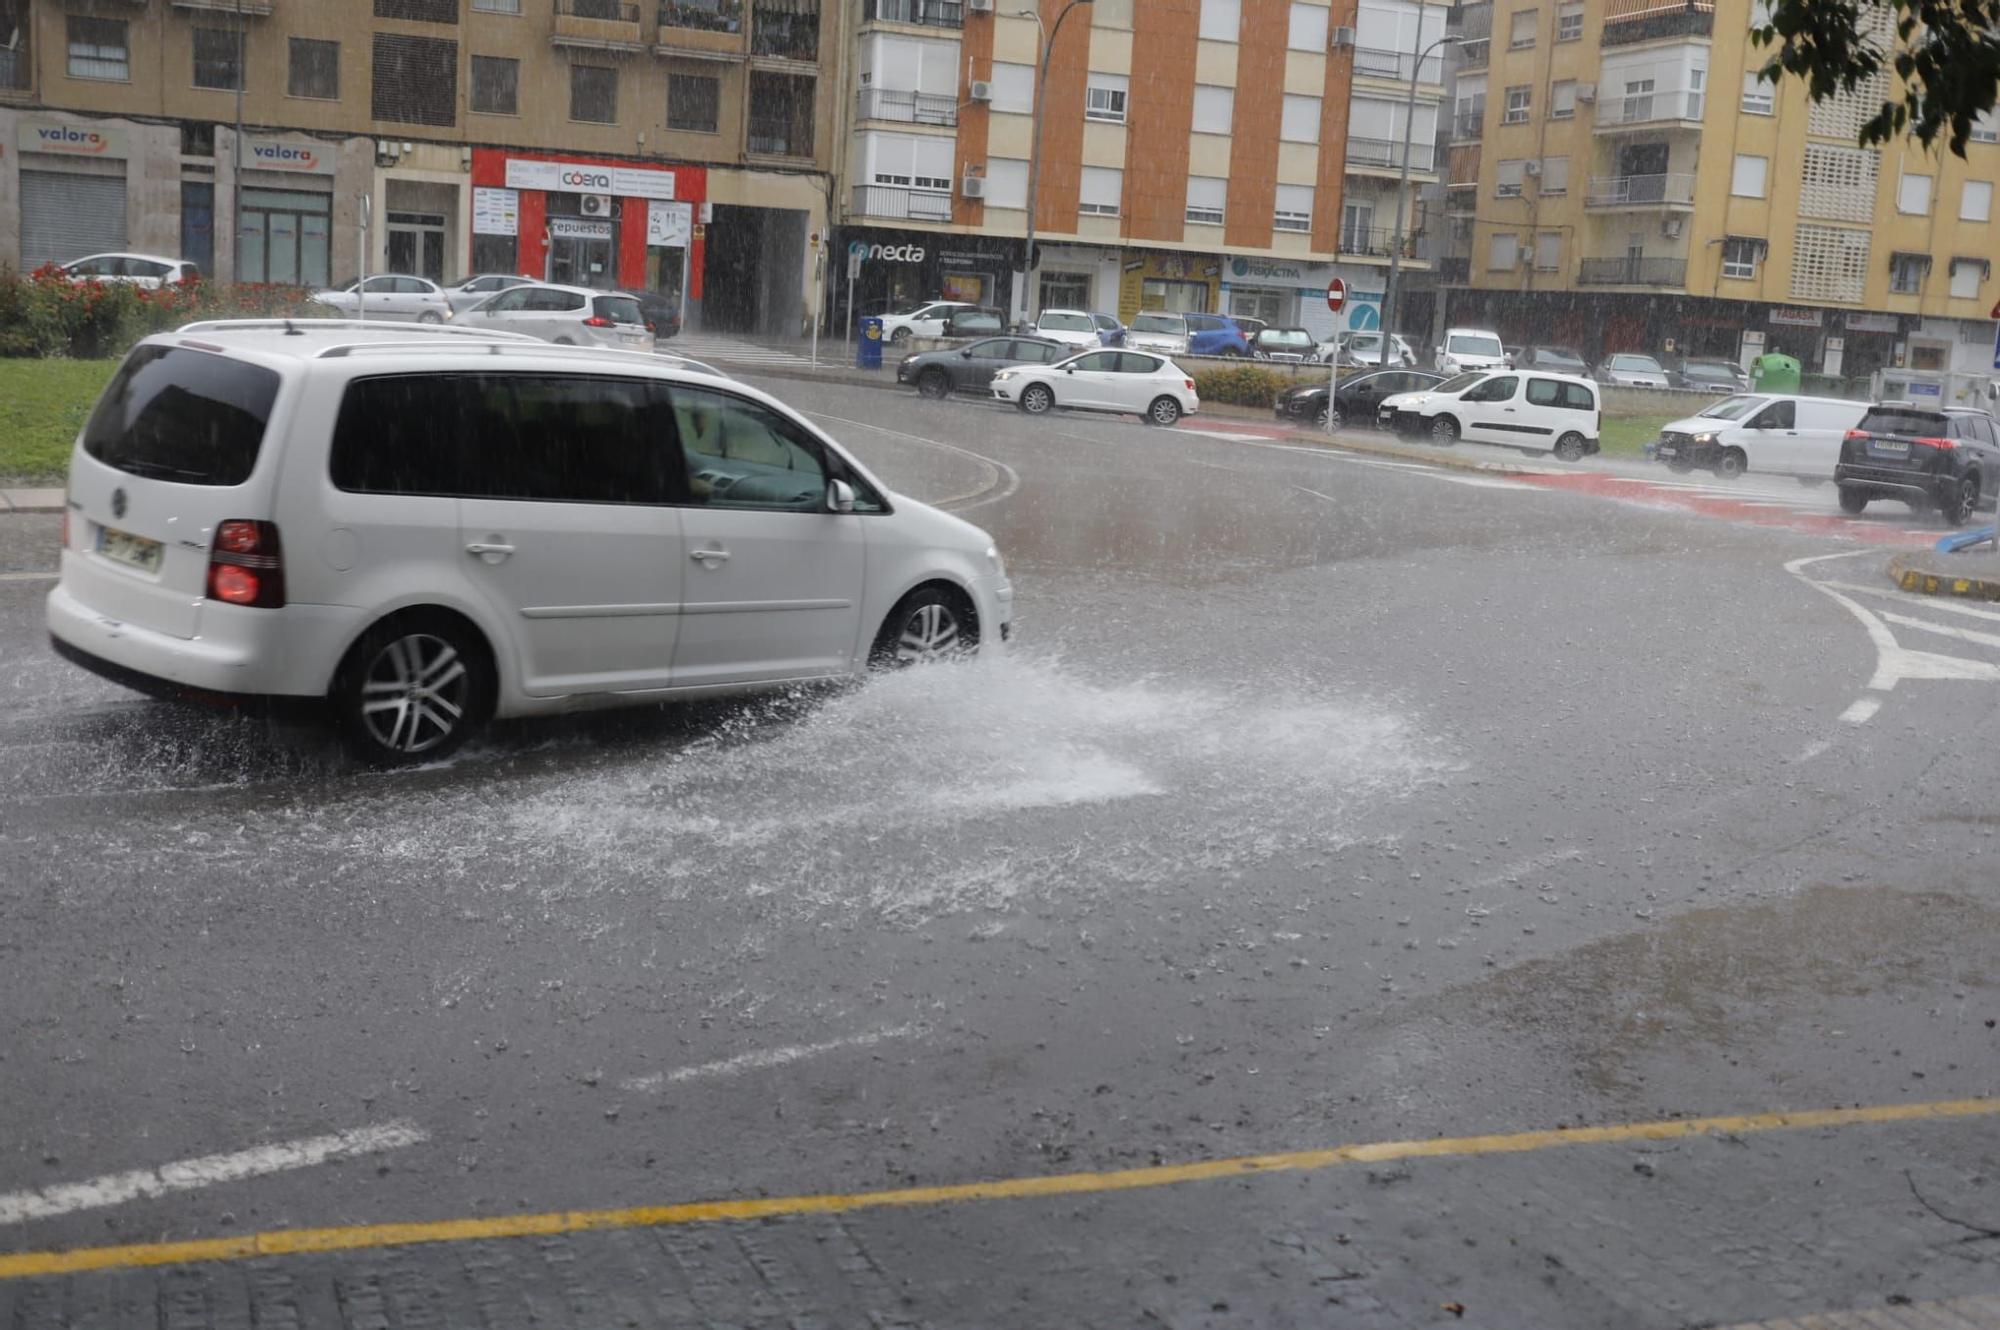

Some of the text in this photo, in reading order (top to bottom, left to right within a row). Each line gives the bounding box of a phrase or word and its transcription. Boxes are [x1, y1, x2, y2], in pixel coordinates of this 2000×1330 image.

[38, 126, 100, 143] valora
[254, 144, 312, 160] valora
[563, 170, 610, 188] coera
[552, 223, 610, 235] repuestos
